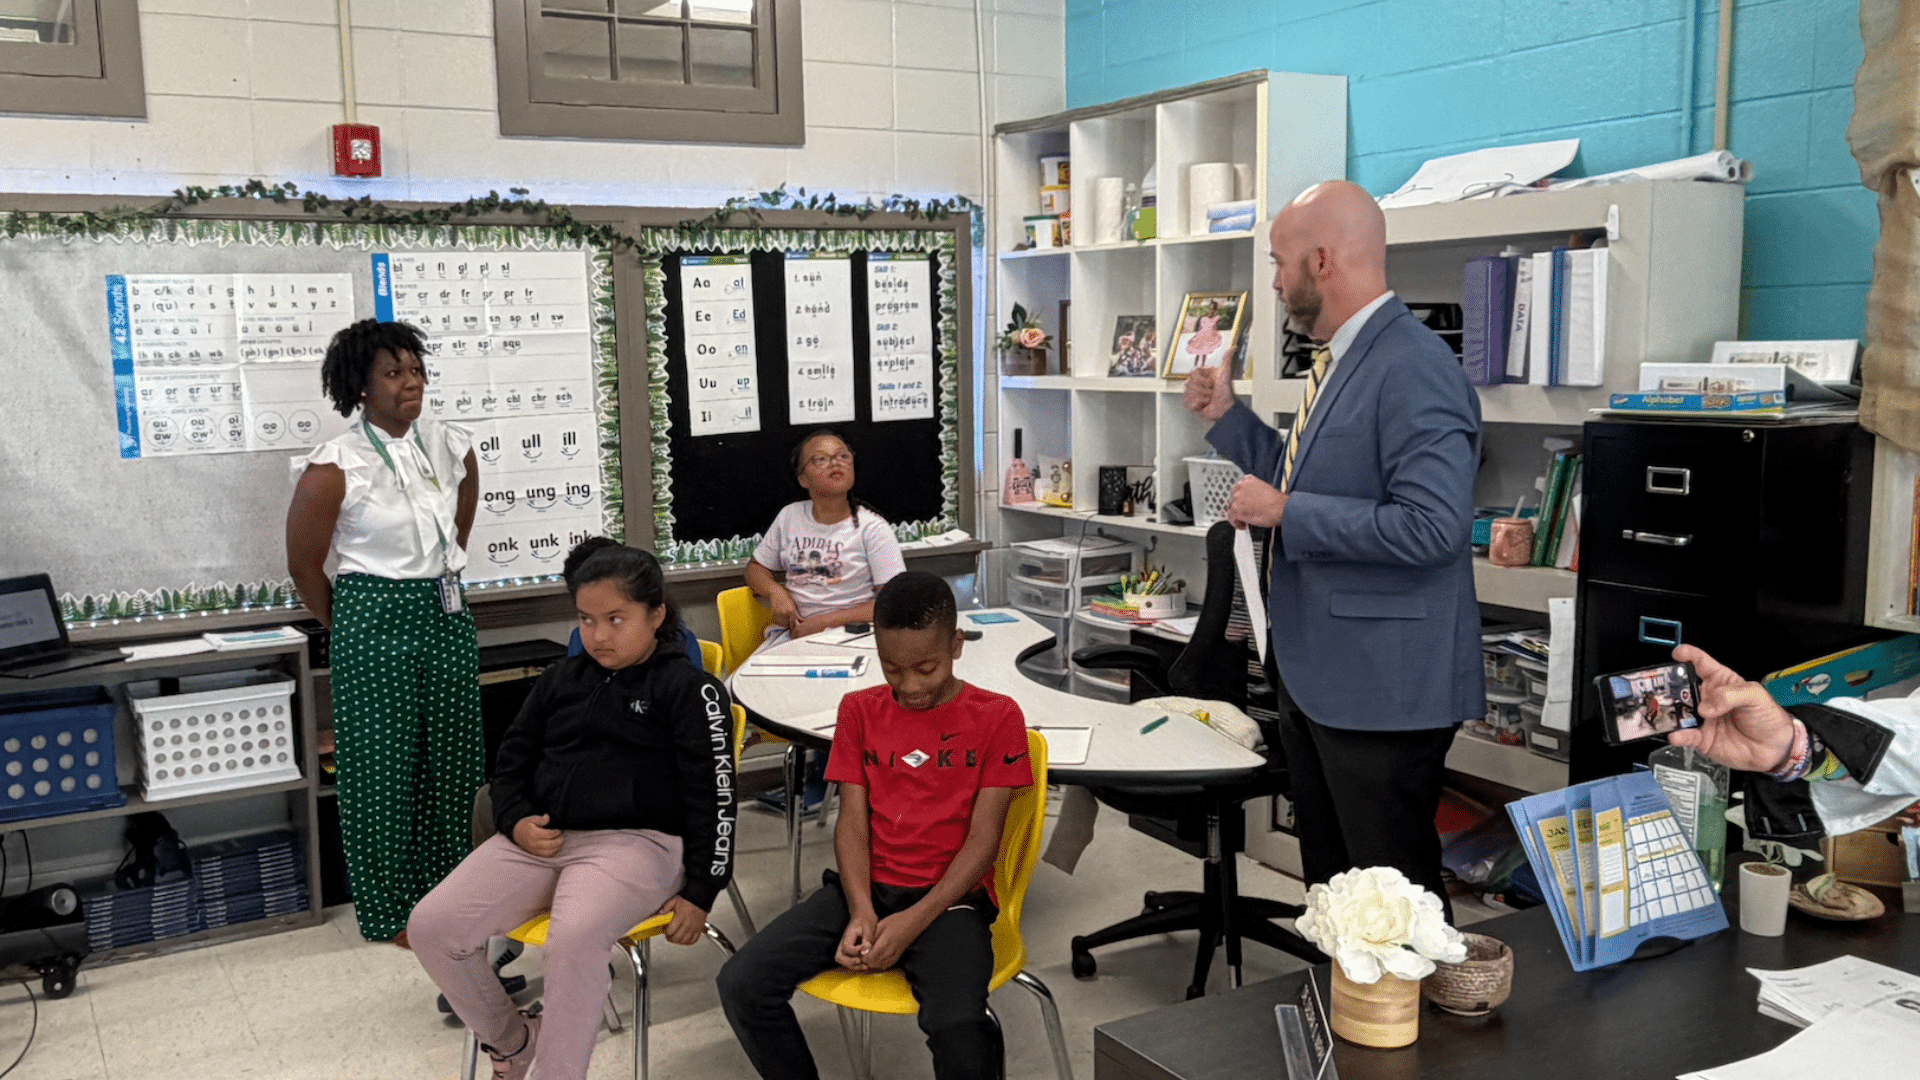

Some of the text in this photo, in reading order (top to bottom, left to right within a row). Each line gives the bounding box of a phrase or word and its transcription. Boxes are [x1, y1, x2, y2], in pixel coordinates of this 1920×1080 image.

[393, 262, 403, 272] bl
[415, 262, 425, 272] cl
[458, 262, 468, 275] gl
[480, 262, 489, 275] pl
[693, 277, 711, 288] Aa
[874, 279, 909, 290] beside
[132, 286, 139, 296] b
[154, 286, 173, 296] c/k
[187, 286, 195, 295] d
[208, 285, 213, 295] f
[226, 287, 234, 298] g
[247, 285, 255, 295] h
[270, 285, 275, 297] j
[327, 286, 334, 294] n
[396, 290, 407, 299] br
[418, 291, 429, 299] cr
[440, 290, 451, 299] dr
[461, 289, 471, 298] fr
[482, 290, 493, 300] gr
[504, 290, 515, 300] pr
[133, 303, 141, 312] p
[229, 299, 235, 309] t
[268, 301, 278, 309] w
[311, 301, 317, 310] y
[330, 300, 337, 308] z
[805, 300, 831, 315] hand
[875, 301, 919, 312] program
[111, 283, 127, 343] 42 Sounds
[695, 308, 746, 322] Ee Ed
[805, 336, 820, 347] go
[876, 336, 915, 347] subject
[697, 343, 717, 356] Oo
[877, 357, 915, 370] explain
[428, 368, 441, 377] tw
[807, 363, 836, 379] smile
[699, 377, 750, 389] Uu up
[141, 388, 154, 396] ar
[165, 387, 178, 396] or
[188, 386, 201, 394] er
[210, 386, 222, 394] ur
[430, 391, 572, 408] thr phl phr chl chr sch
[808, 397, 834, 411] train
[879, 395, 929, 409] introduce
[153, 420, 168, 428] au
[191, 419, 205, 427] ou
[228, 415, 239, 425] oi
[701, 410, 712, 422] Ii
[154, 433, 171, 441] aw
[480, 431, 577, 452] oll ull ill
[484, 482, 591, 505] ong ung ing
[487, 537, 519, 553] onk
[530, 533, 560, 549] unk
[700, 683, 735, 877] Calvin Klein Jeans
